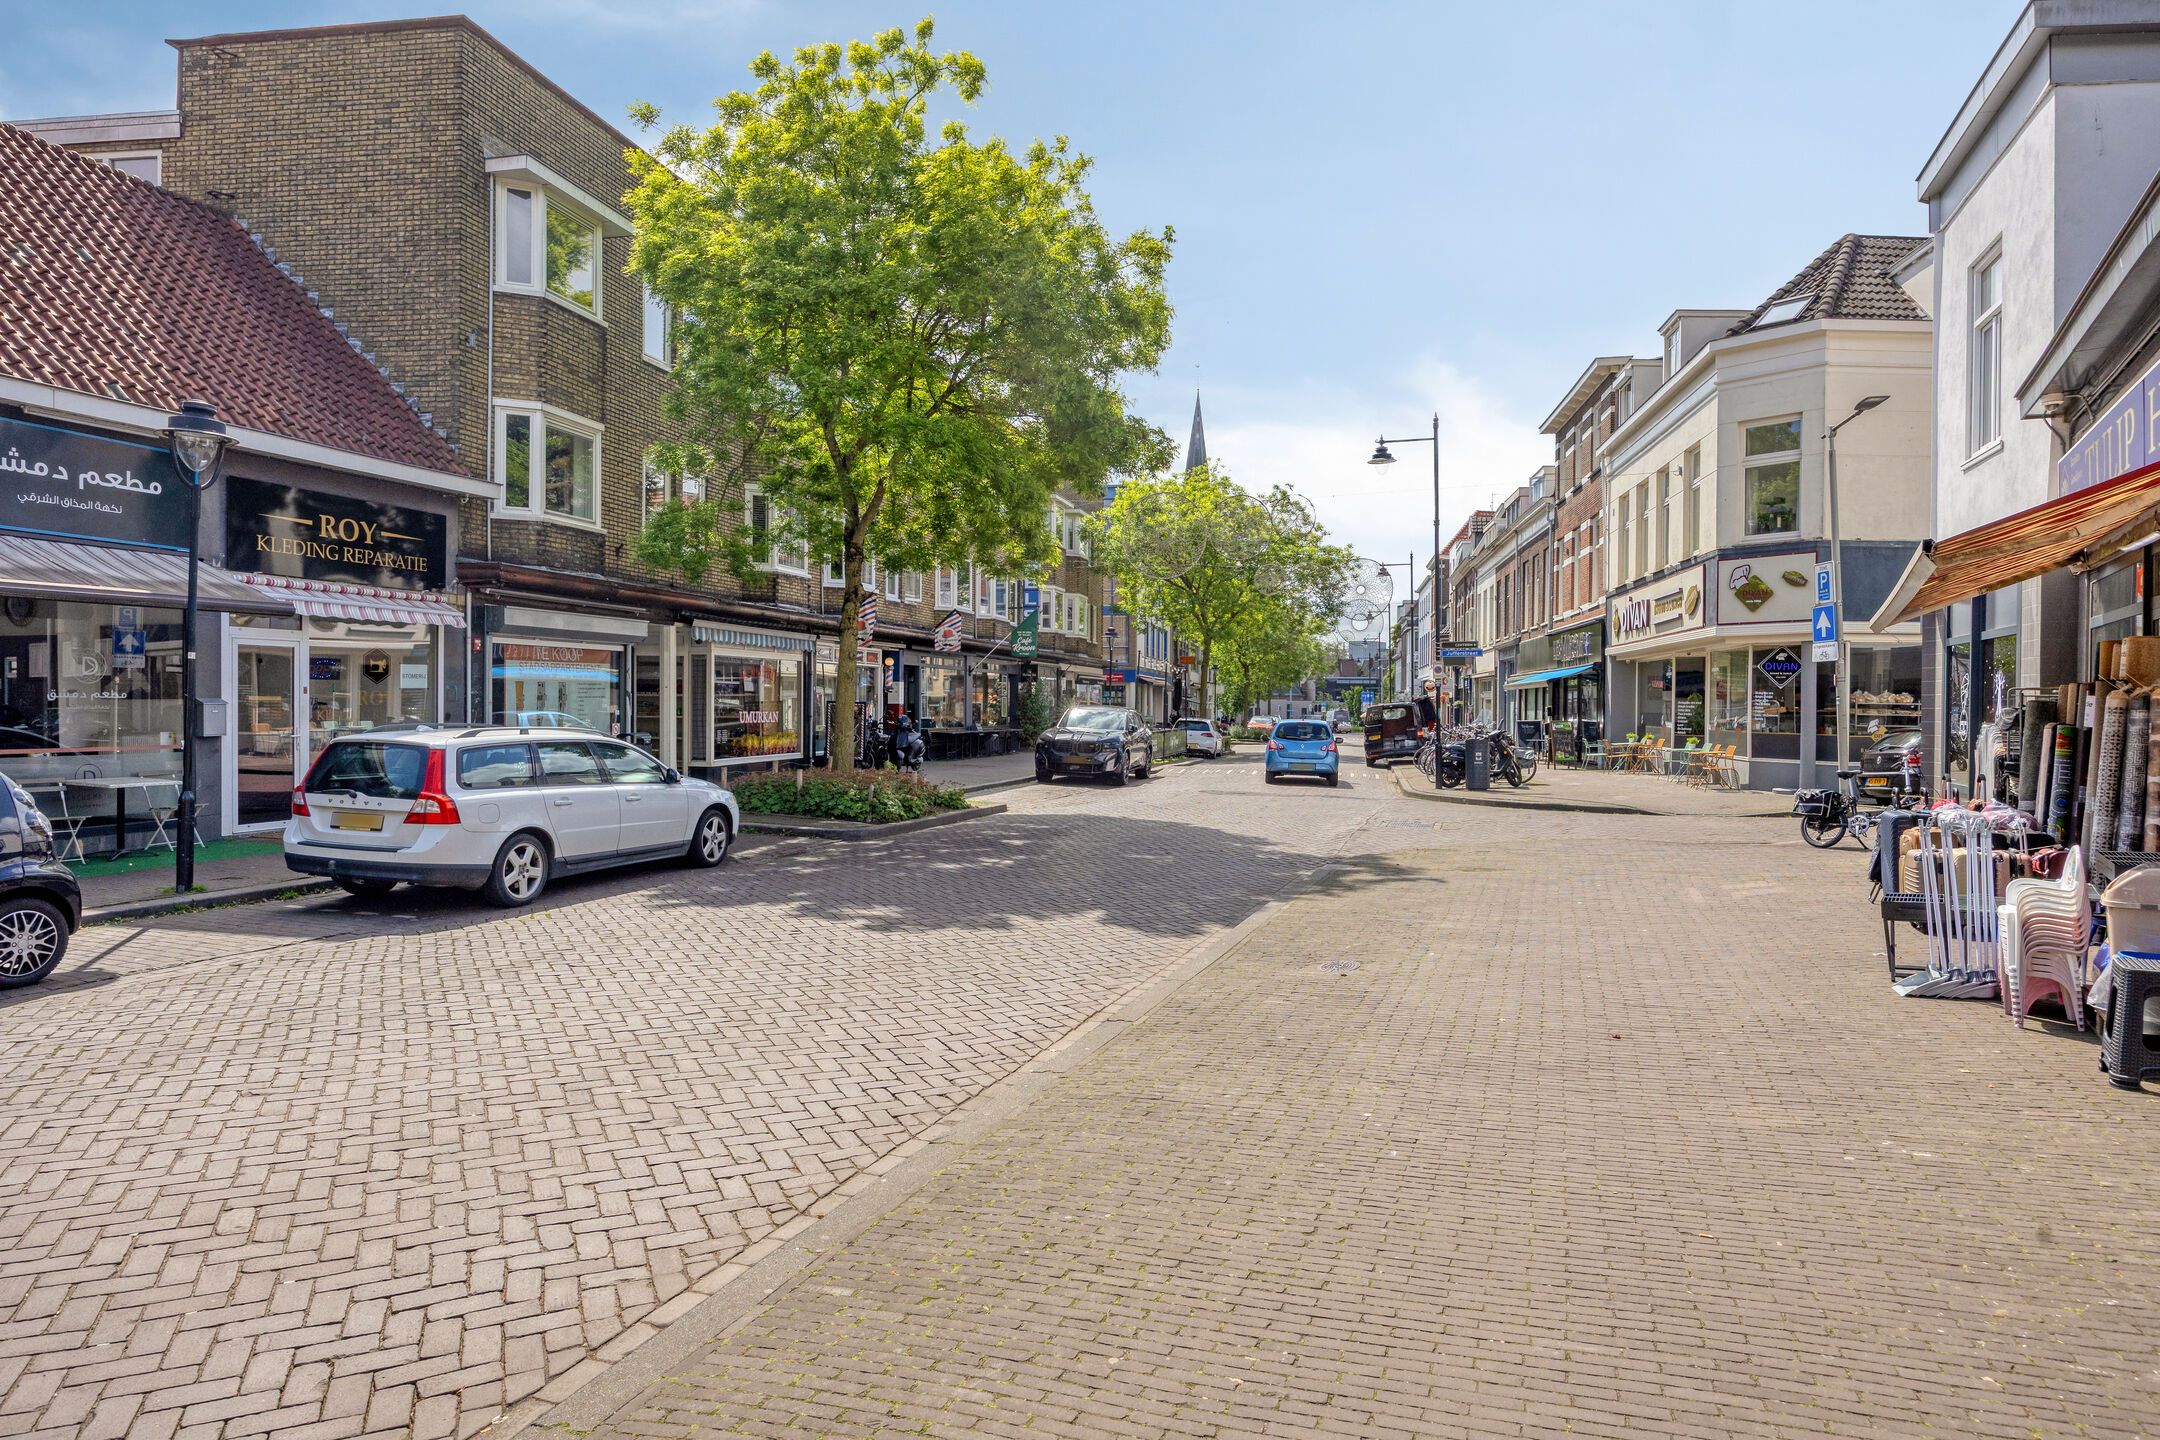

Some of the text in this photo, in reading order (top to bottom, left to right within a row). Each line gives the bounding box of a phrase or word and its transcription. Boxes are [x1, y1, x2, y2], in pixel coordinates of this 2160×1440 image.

[2085, 408, 2135, 487] TULIP
[0, 447, 163, 496] مطعم دمش
[17, 492, 123, 514] نكهة المذاق الشرقي
[319, 514, 378, 545] ROY
[256, 534, 428, 572] KLEDING REPARATIE
[1820, 572, 1828, 589] P
[1012, 643, 1036, 652] Kroon
[519, 662, 601, 673] STADSAPPARTEMENT
[1765, 662, 1798, 671] DIVAN
[739, 711, 779, 724] UMURKAN
[328, 798, 382, 807] VOLVO
